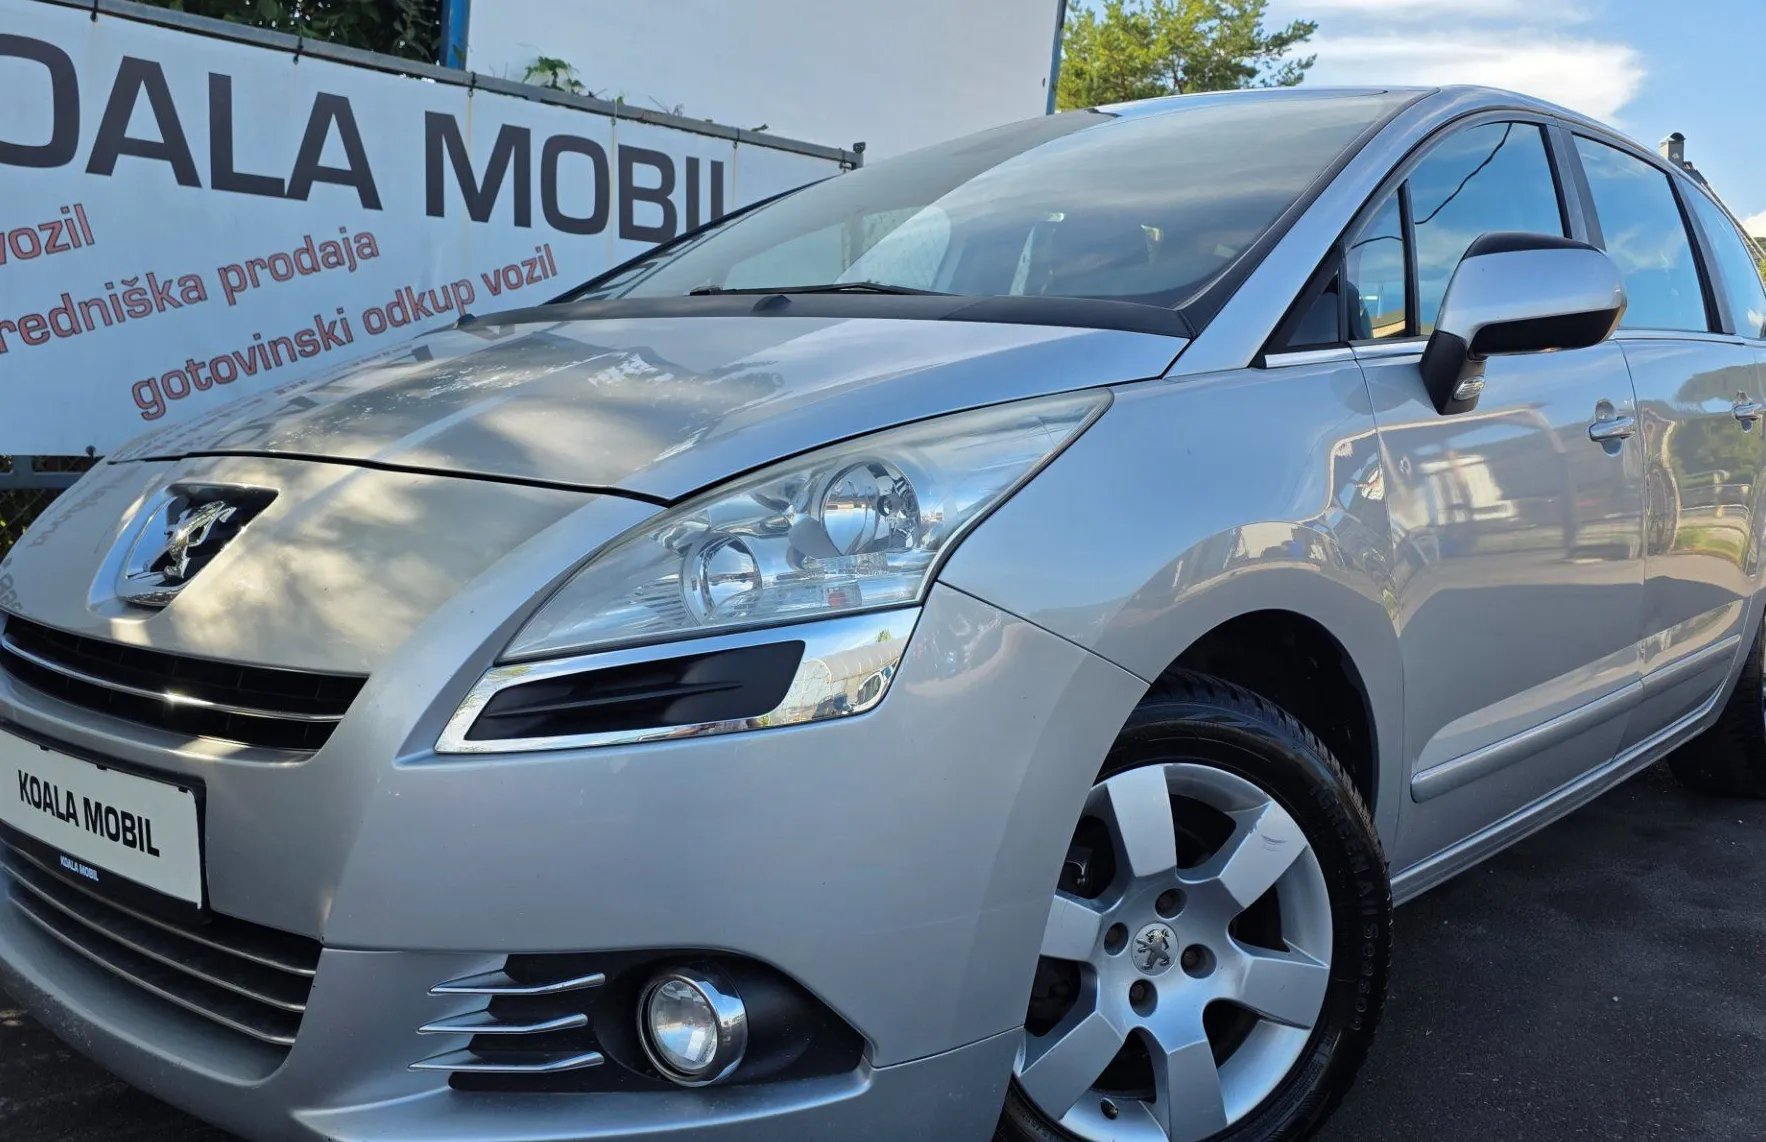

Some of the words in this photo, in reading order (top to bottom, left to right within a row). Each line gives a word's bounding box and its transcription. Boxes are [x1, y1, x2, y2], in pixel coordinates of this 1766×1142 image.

[0, 203, 95, 265] ozil
[218, 227, 379, 306] prodaja
[131, 307, 354, 421] gotovinski
[362, 276, 476, 336] odkup
[481, 243, 558, 296] vozil
[18, 769, 80, 827] KOALA
[83, 797, 160, 857] MOBIL
[60, 855, 79, 873] KOALA
[79, 863, 99, 881] MOBIL
